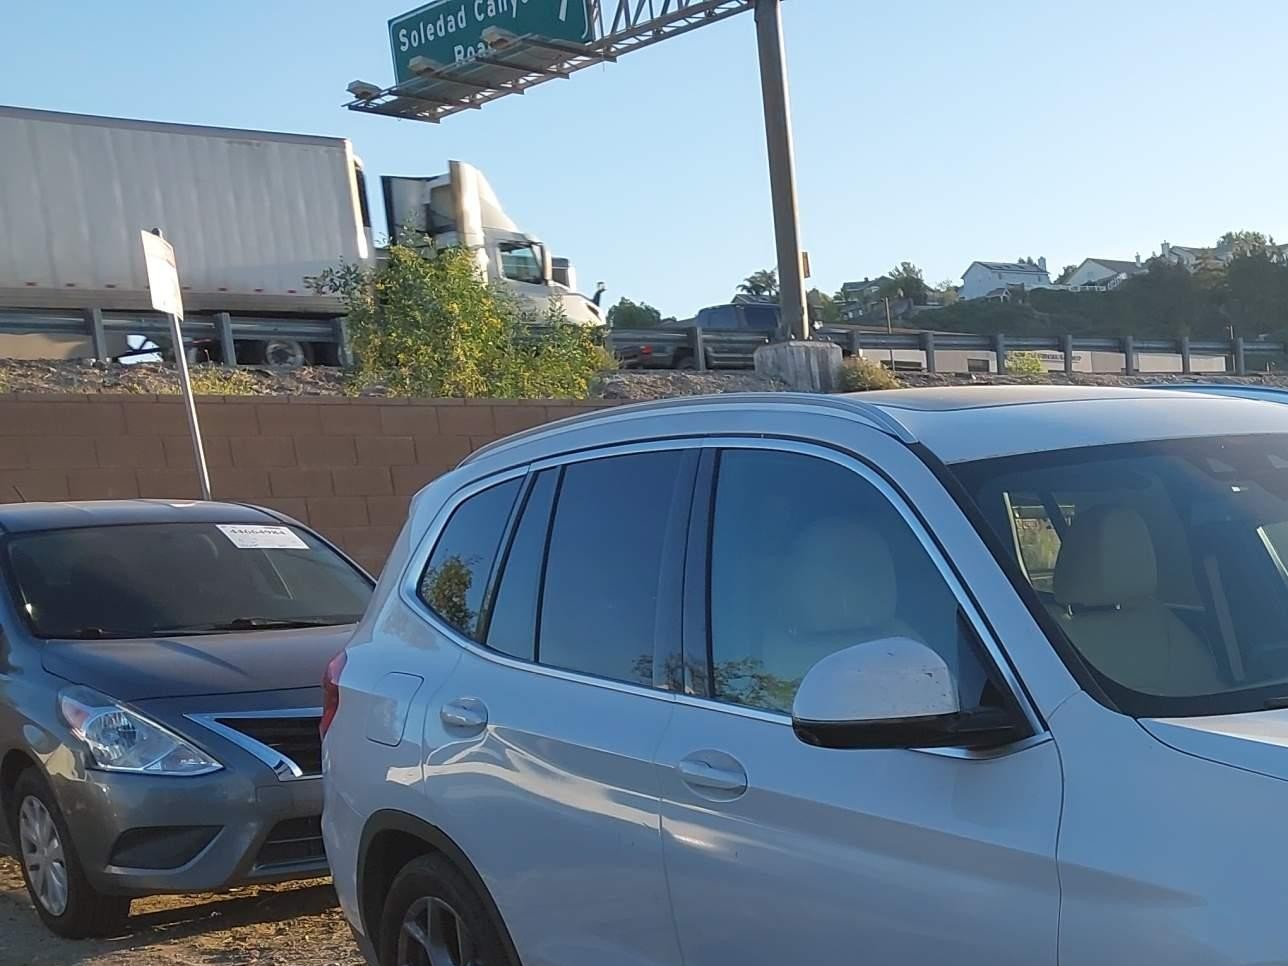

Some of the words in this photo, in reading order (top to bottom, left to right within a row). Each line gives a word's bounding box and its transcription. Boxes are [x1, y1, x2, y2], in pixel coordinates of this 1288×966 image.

[399, 4, 467, 52] Soledad
[474, 0, 529, 22] Cany
[454, 41, 491, 65] Roa
